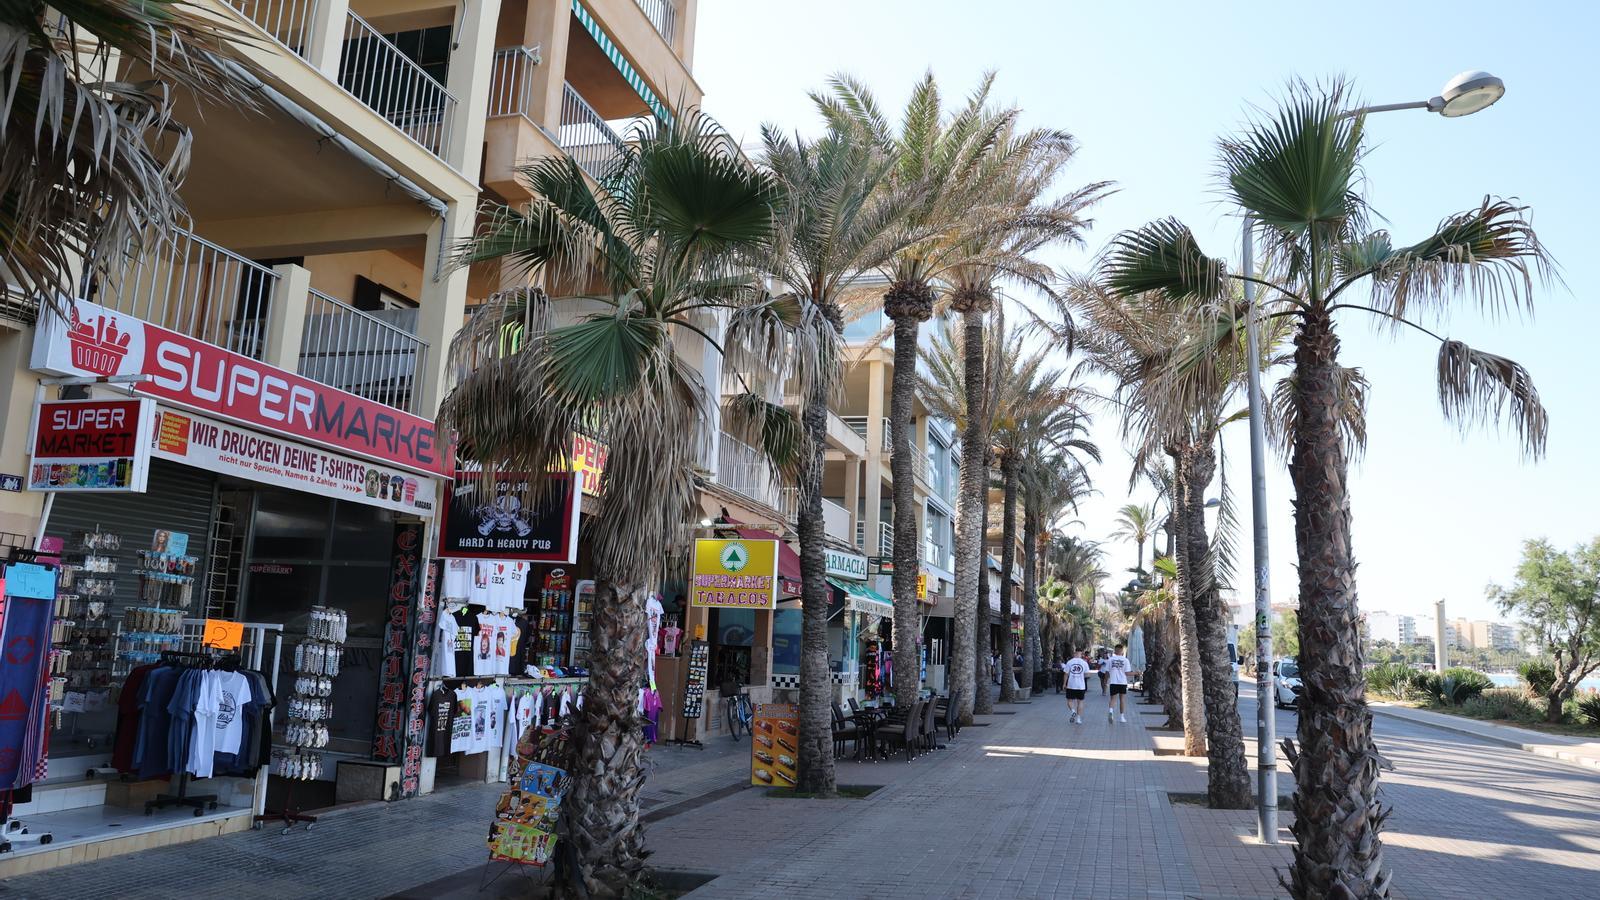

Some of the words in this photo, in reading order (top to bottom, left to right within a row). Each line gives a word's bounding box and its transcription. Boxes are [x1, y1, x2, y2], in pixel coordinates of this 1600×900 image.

[154, 341, 455, 466] SUPERMARKE
[52, 408, 125, 430] SUPER
[41, 432, 132, 454] MARKET
[192, 421, 218, 448] WIR
[220, 430, 281, 464] DRUCKEN
[283, 446, 318, 473] DEINE
[320, 455, 365, 484] T-SHIRTS
[218, 454, 238, 465] nicht
[239, 461, 252, 469] nur
[284, 469, 309, 481] Namen
[316, 476, 338, 488] Zahlen
[497, 538, 529, 549] HEAVY
[532, 540, 551, 550] PUB
[825, 557, 866, 576] ARMACIA
[491, 576, 505, 585] SEX
[694, 574, 772, 590] SUPERMARKET
[697, 591, 768, 606] TABACOS
